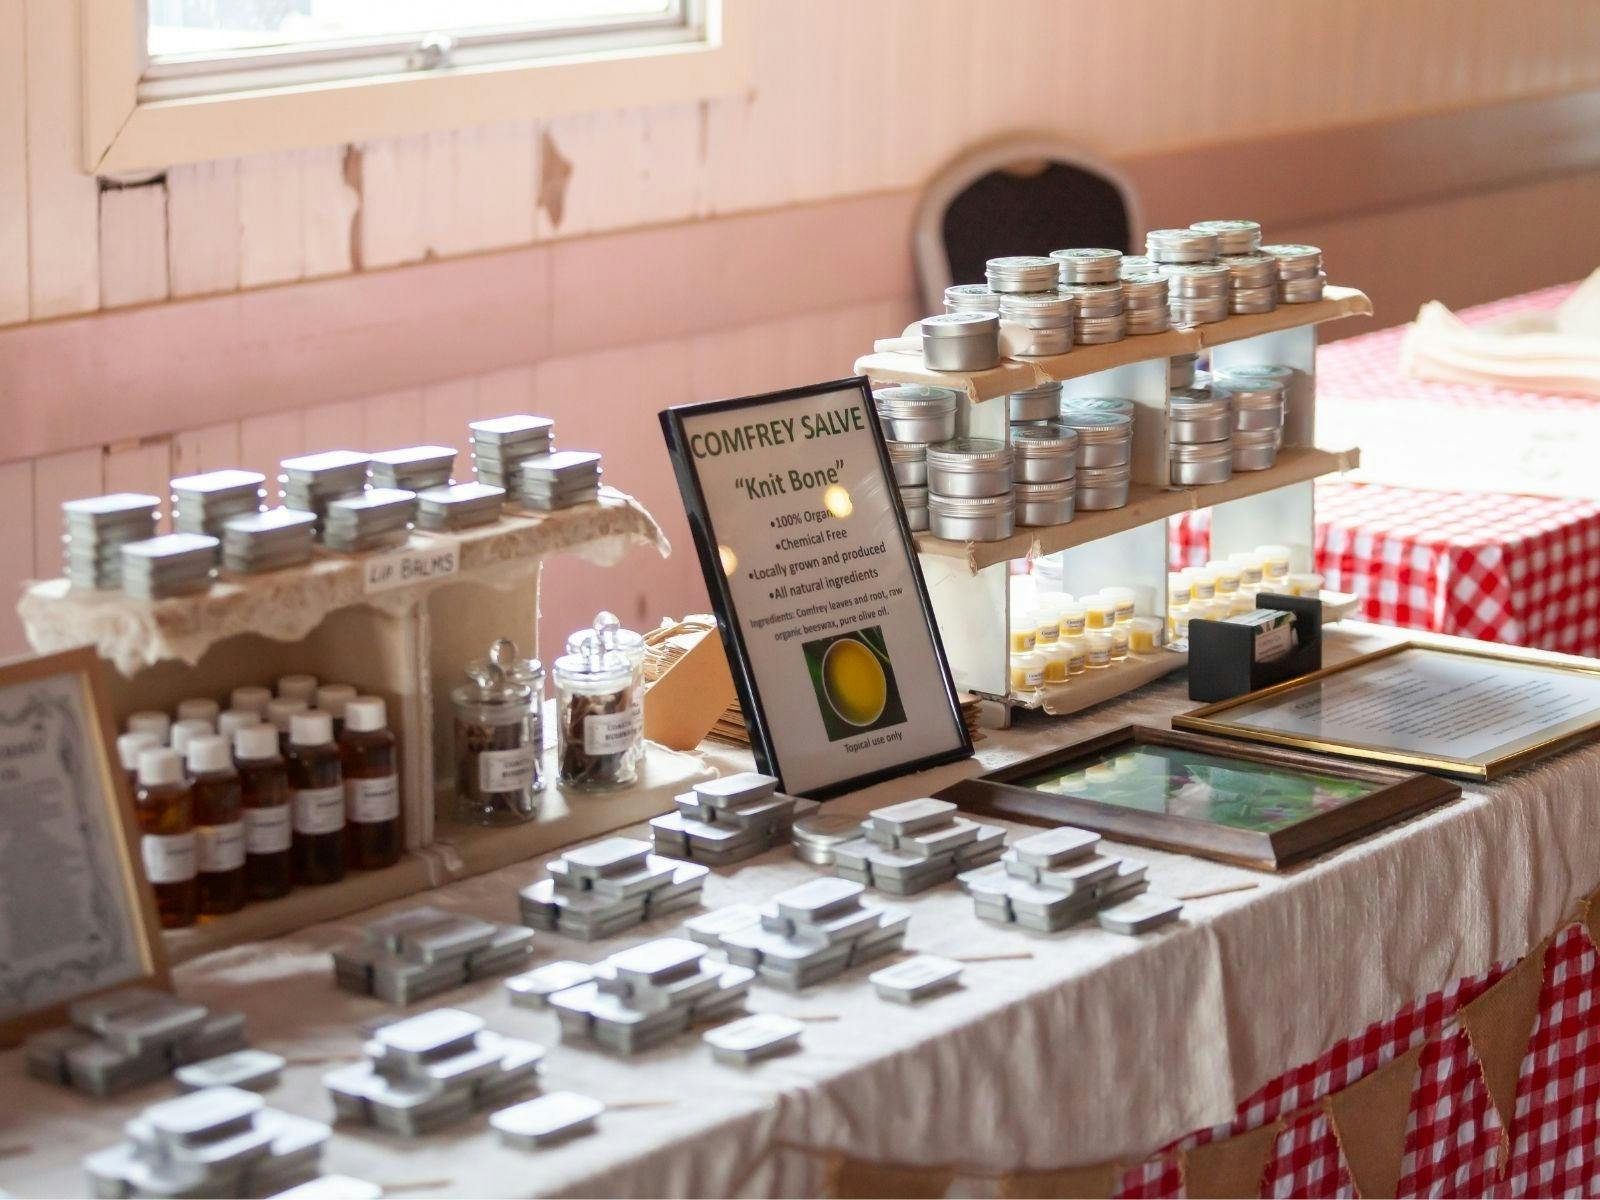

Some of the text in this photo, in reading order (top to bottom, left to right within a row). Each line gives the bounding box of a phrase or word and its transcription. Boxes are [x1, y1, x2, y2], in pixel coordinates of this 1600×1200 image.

[690, 406, 865, 459] COMFREY SALVE
[735, 459, 844, 500] “Knit Bone”
[804, 507, 838, 524] Organ
[781, 528, 848, 551] Chemical Free
[401, 553, 454, 579] BALMS
[753, 541, 886, 580] Locally grown and produced
[775, 567, 879, 600] All natural ingredients
[750, 587, 903, 629] Ingredients: Comfrey leaves and root, raw
[774, 606, 889, 642] organic beeswax, pure olive oil.
[844, 730, 902, 753] Topical use only
